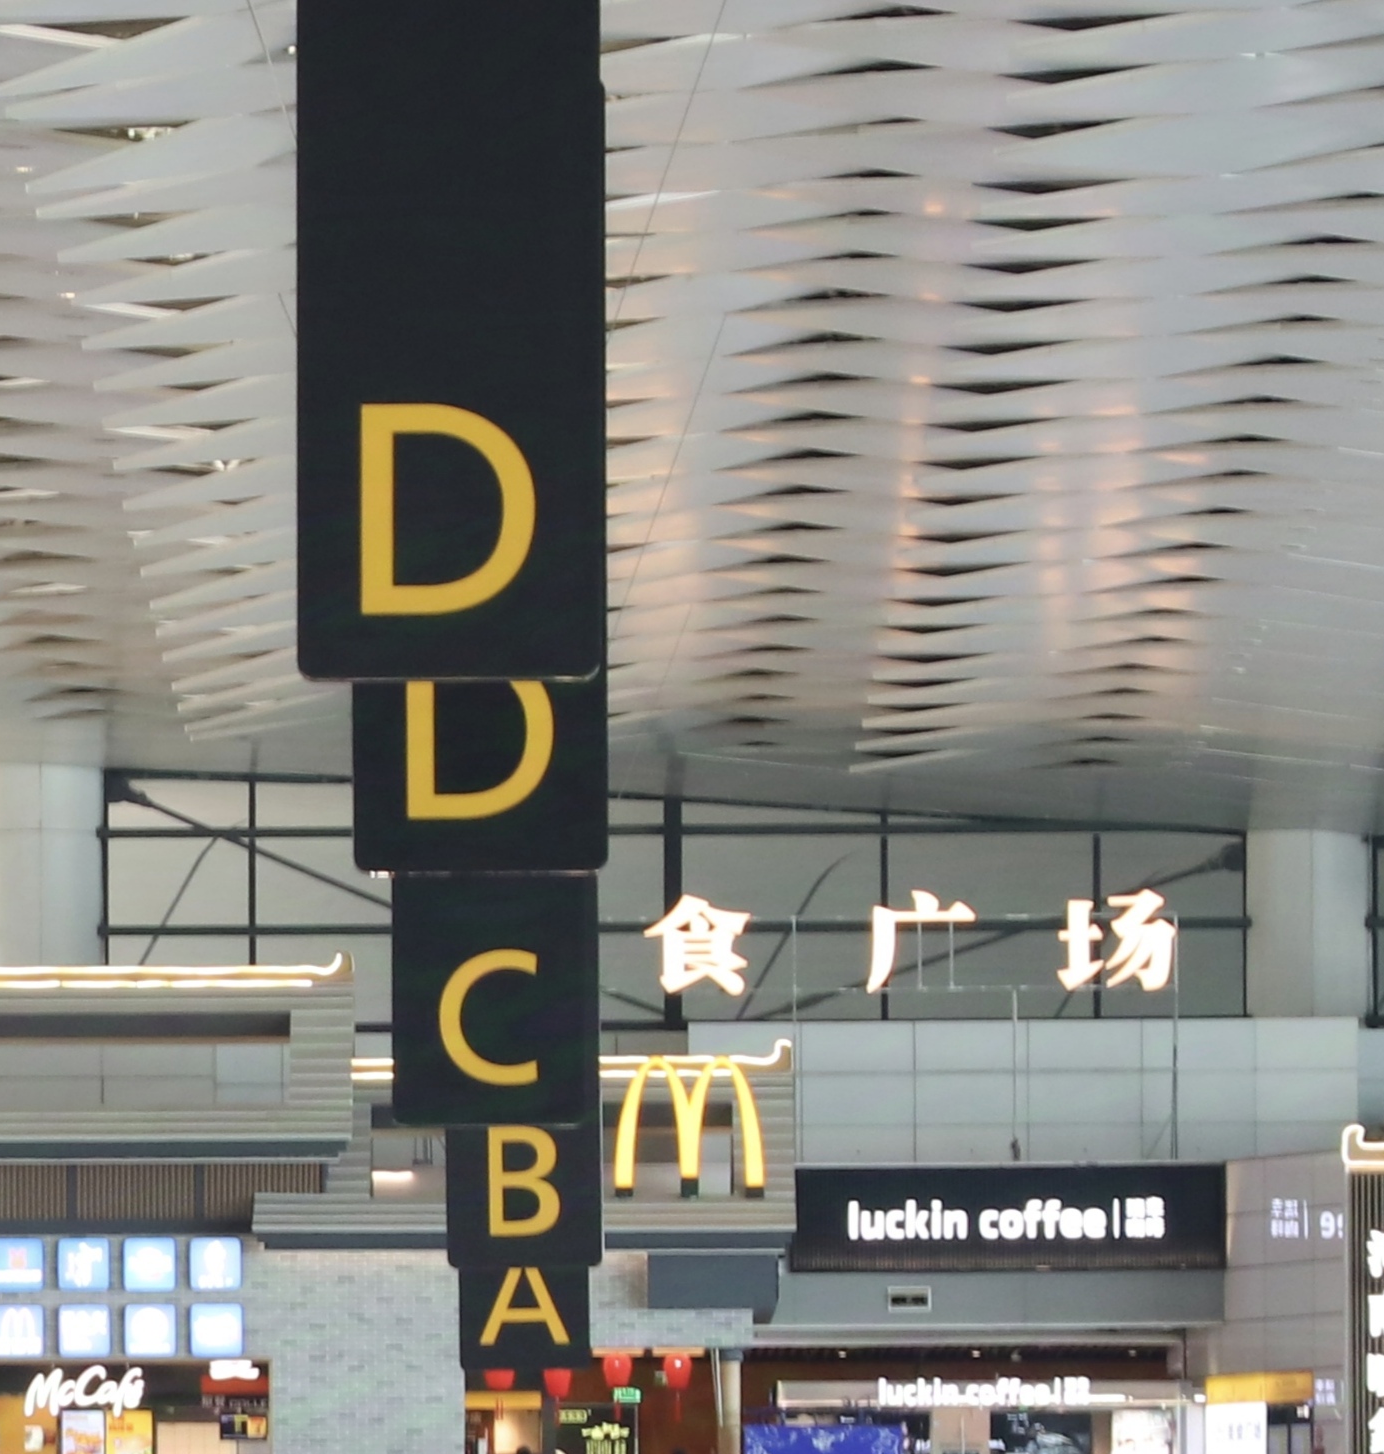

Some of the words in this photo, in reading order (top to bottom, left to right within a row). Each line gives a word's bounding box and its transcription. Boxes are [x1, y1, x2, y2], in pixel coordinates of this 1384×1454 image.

[360, 403, 536, 616] D
[405, 681, 554, 821] D
[439, 948, 538, 1086] C
[488, 1126, 561, 1238] B
[847, 1199, 968, 1241] luckin
[978, 1197, 1107, 1241] coffee
[479, 1267, 570, 1346] A
[878, 1377, 959, 1406] luckin
